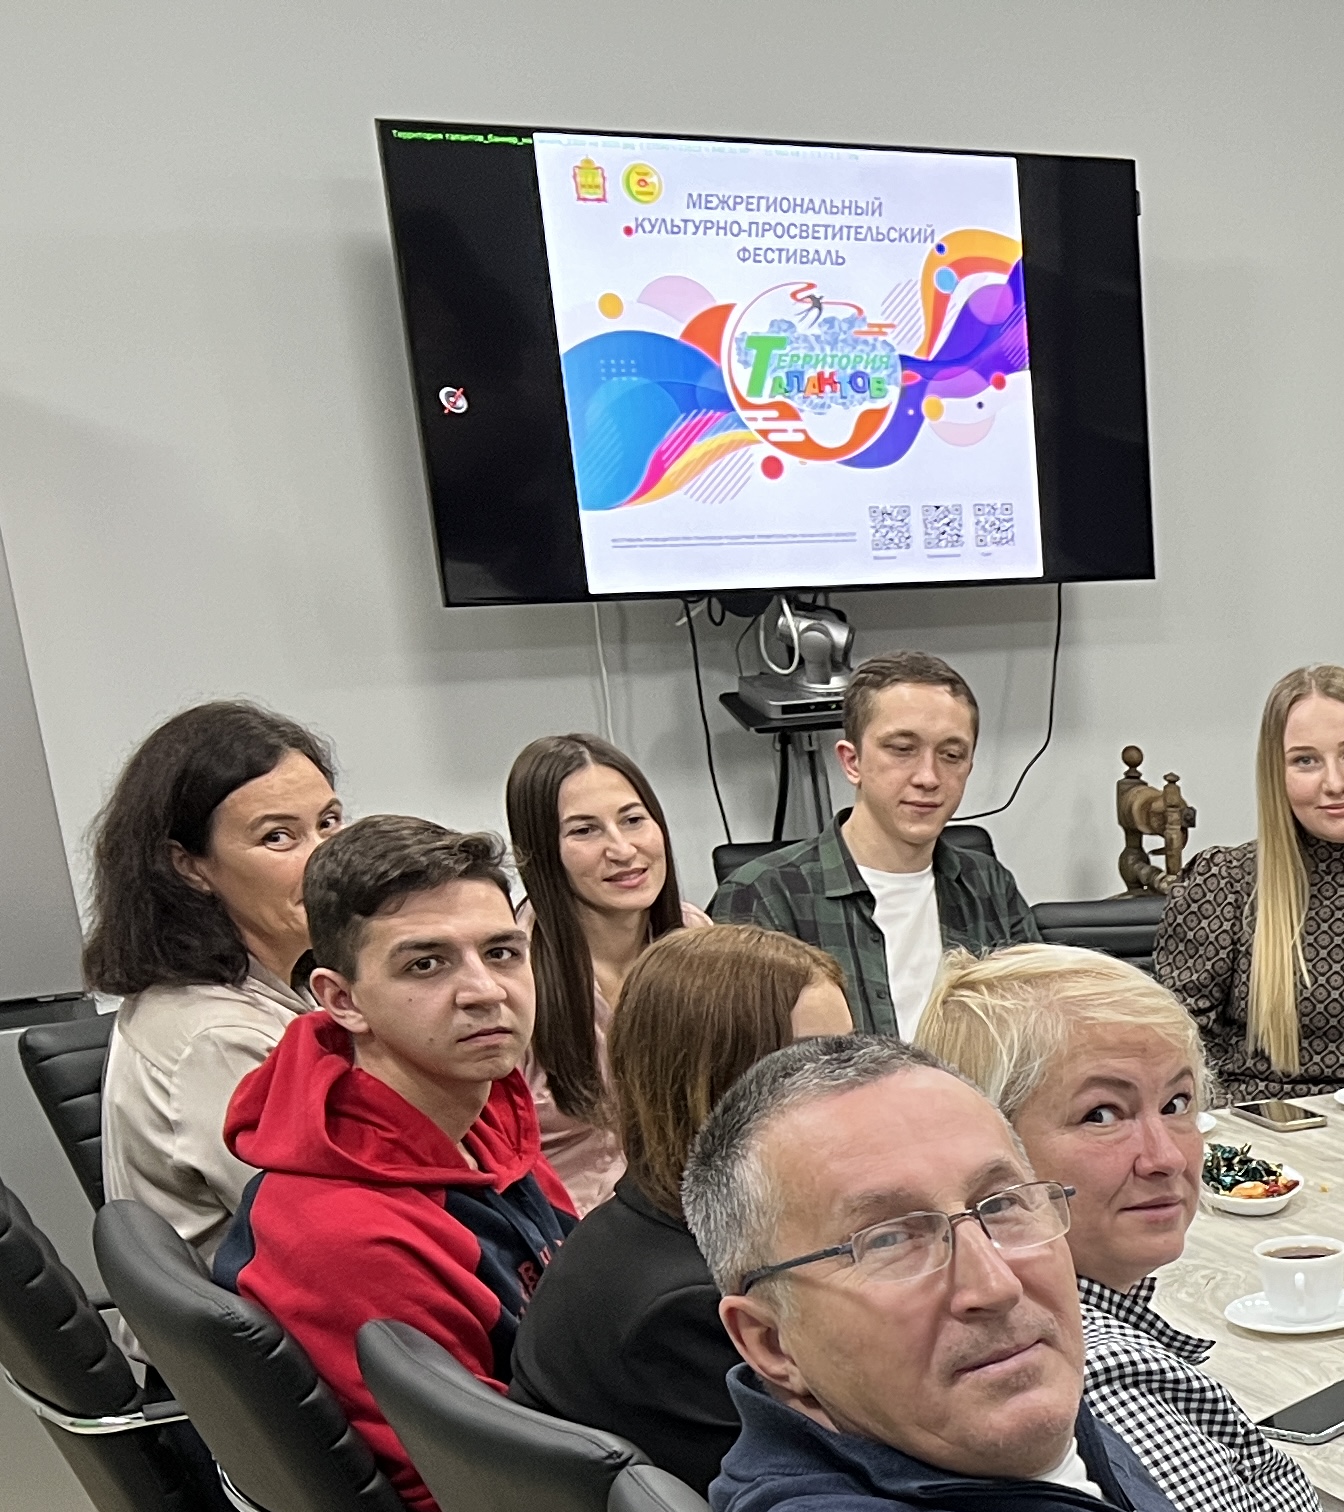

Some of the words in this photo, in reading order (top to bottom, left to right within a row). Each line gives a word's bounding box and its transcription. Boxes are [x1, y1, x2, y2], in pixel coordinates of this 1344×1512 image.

[686, 192, 883, 217] МЕЖРЕГИОНАЛЬНЫЙ
[634, 216, 936, 244] КУЛЬТУРНО-ПРОСВЕТИТЕЛЬСКИЙ
[736, 245, 847, 266] ФЕСТИВАЛЬ
